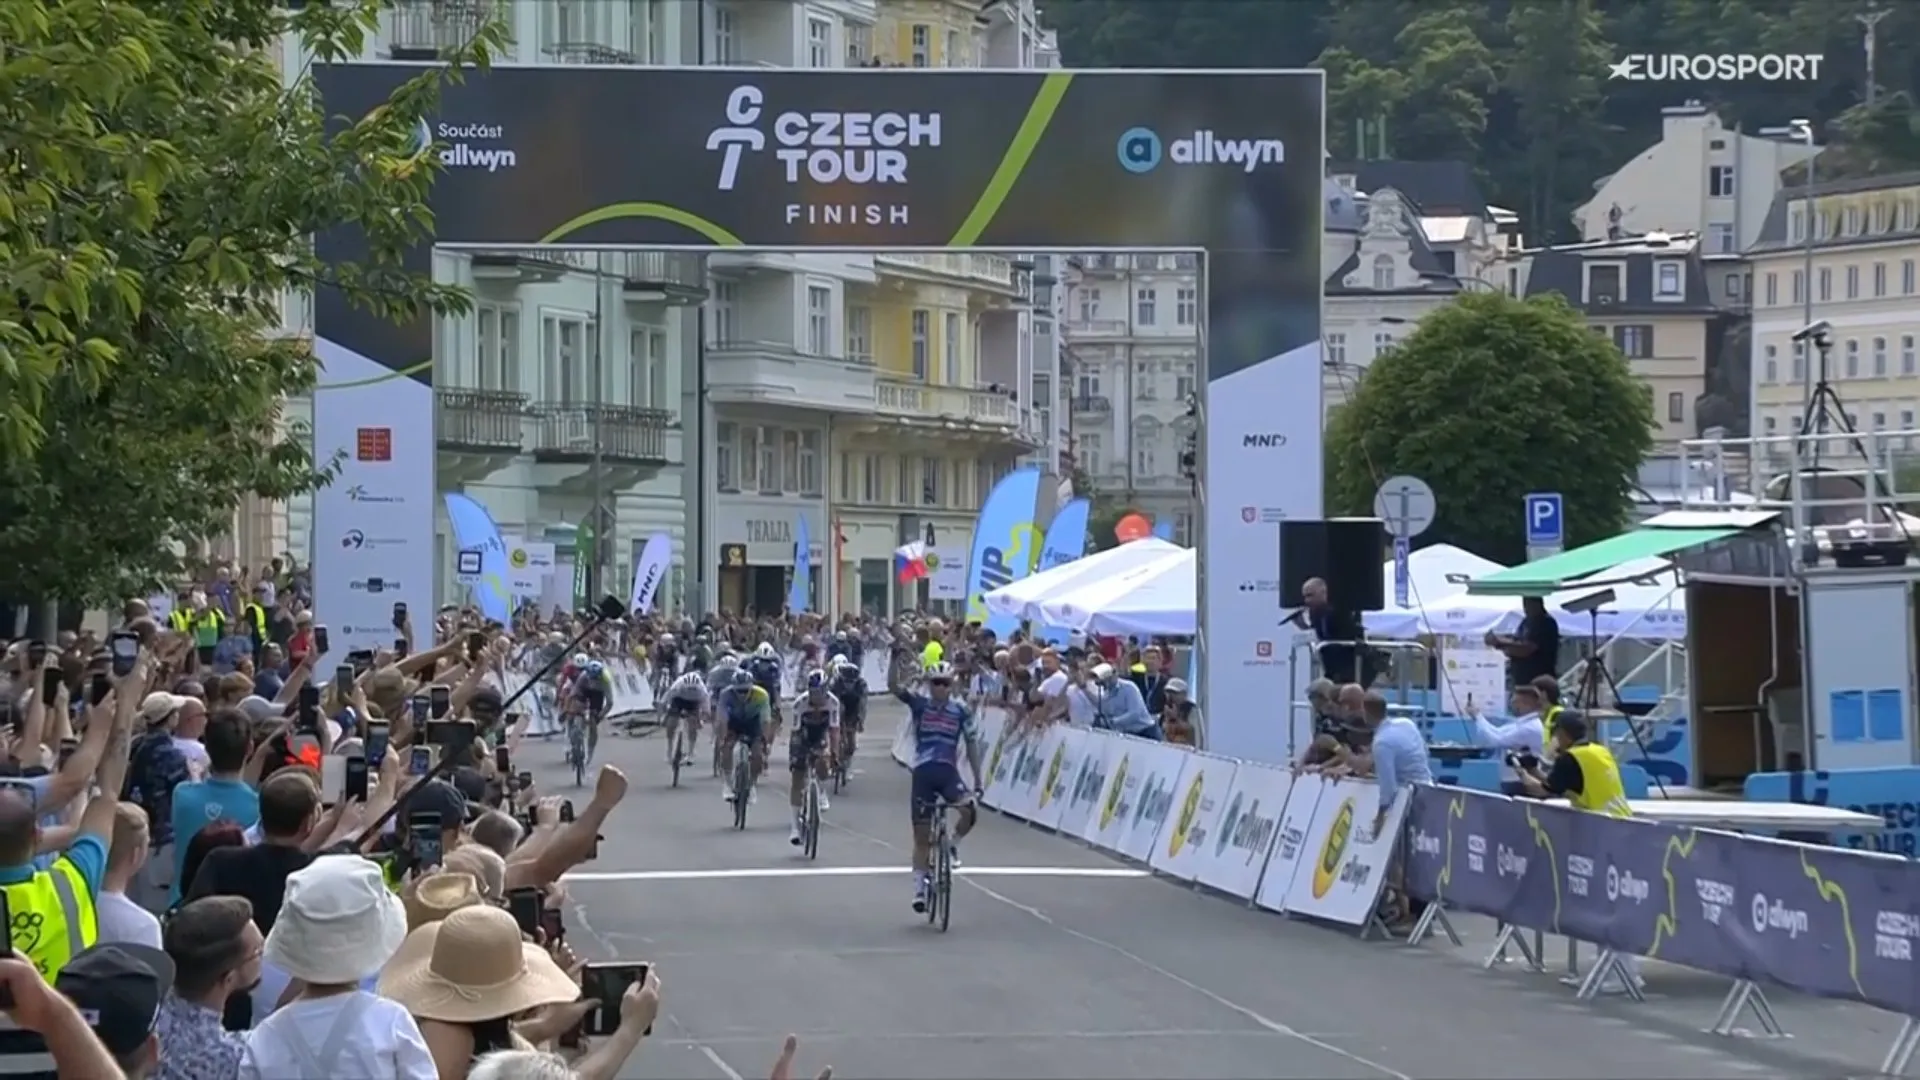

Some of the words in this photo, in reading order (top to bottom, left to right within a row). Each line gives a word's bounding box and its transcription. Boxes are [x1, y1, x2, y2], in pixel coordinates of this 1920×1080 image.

[438, 123, 503, 138] Součást
[773, 111, 942, 148] CZECH
[439, 143, 516, 173] allwyn
[775, 148, 909, 184] TOUR
[1169, 130, 1286, 174] allwyn
[785, 204, 910, 225] FINISH
[1243, 434, 1287, 447] MND
[1533, 500, 1555, 529] P
[745, 519, 791, 543] THALIA
[637, 562, 658, 605] MND
[1768, 899, 1808, 940] allwyn
